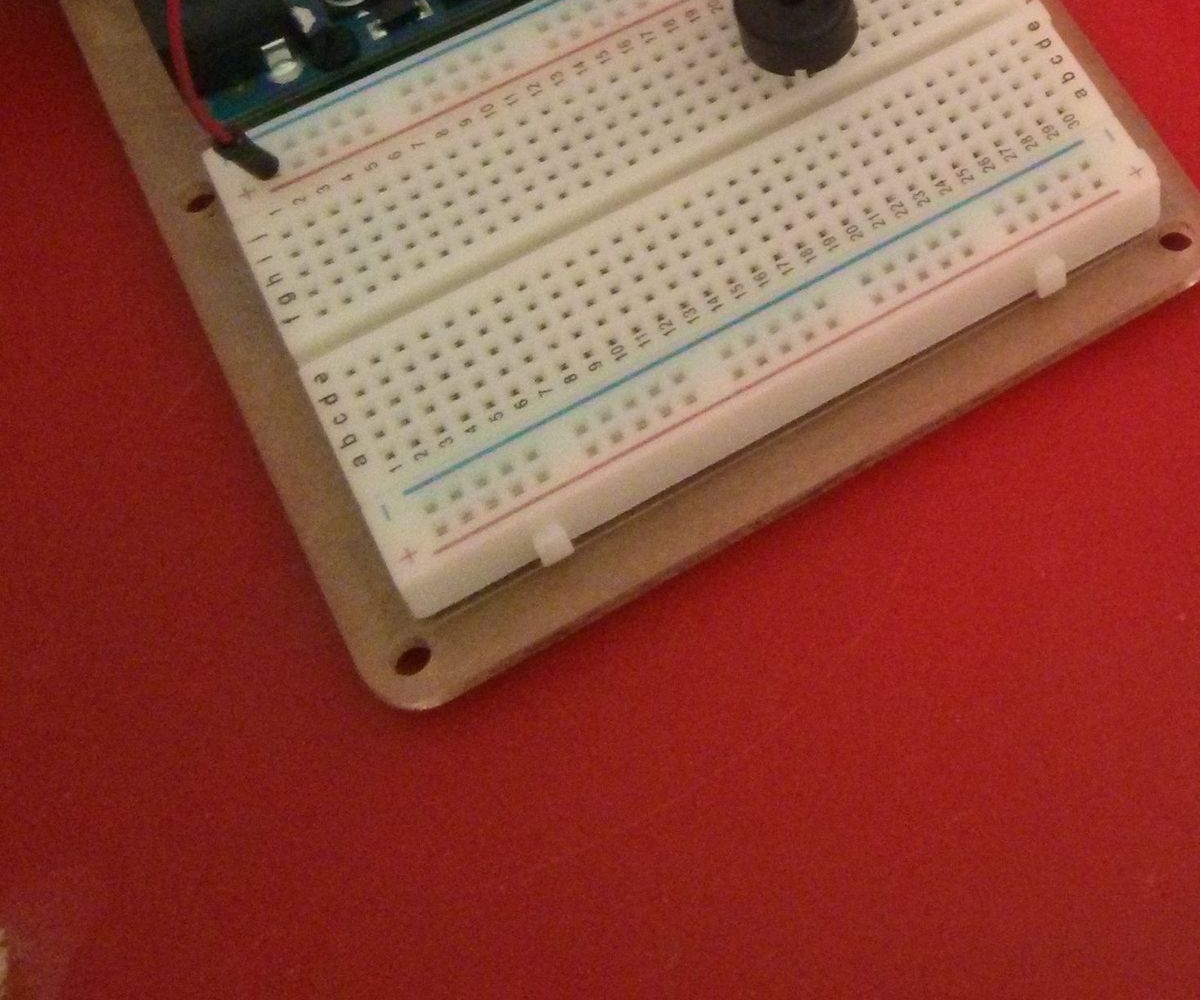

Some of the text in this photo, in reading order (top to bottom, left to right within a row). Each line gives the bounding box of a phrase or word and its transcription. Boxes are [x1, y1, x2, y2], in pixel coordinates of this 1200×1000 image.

[686, 9, 702, 23] 19
[663, 19, 678, 33] 18
[1027, 21, 1040, 32] e
[640, 32, 654, 43] 17
[1035, 38, 1051, 49] d
[618, 40, 632, 54] 16
[596, 50, 612, 64] 15
[1050, 55, 1063, 65] c
[573, 61, 589, 75] 14
[550, 72, 563, 86] 13
[1062, 72, 1075, 84] b
[527, 83, 542, 97] 12
[1074, 88, 1087, 99] a
[505, 94, 519, 106] 11
[480, 104, 495, 118] 10
[1063, 114, 1079, 129] 30
[1042, 125, 1059, 140] 29
[1021, 135, 1038, 151] 28
[998, 149, 1017, 162] 27
[978, 157, 995, 173] 26
[956, 169, 974, 184] 25
[935, 180, 952, 195] 24
[913, 191, 930, 207] 23
[890, 202, 908, 218] 22
[868, 214, 886, 228] 21
[846, 225, 863, 241] 20
[823, 236, 838, 252] 19
[800, 248, 816, 264] 18
[776, 263, 793, 275] 17
[267, 273, 283, 287] h
[753, 272, 768, 287] 16
[278, 292, 296, 305] g
[730, 284, 745, 299] 15
[707, 296, 722, 312] 14
[282, 315, 300, 324] f
[683, 307, 699, 324] 13
[658, 320, 675, 336] 12
[635, 333, 650, 348] 11
[611, 345, 627, 362] 10
[314, 372, 329, 384] e
[319, 393, 339, 406] d
[333, 413, 348, 425] c
[341, 434, 358, 449] b
[353, 454, 367, 467] a
